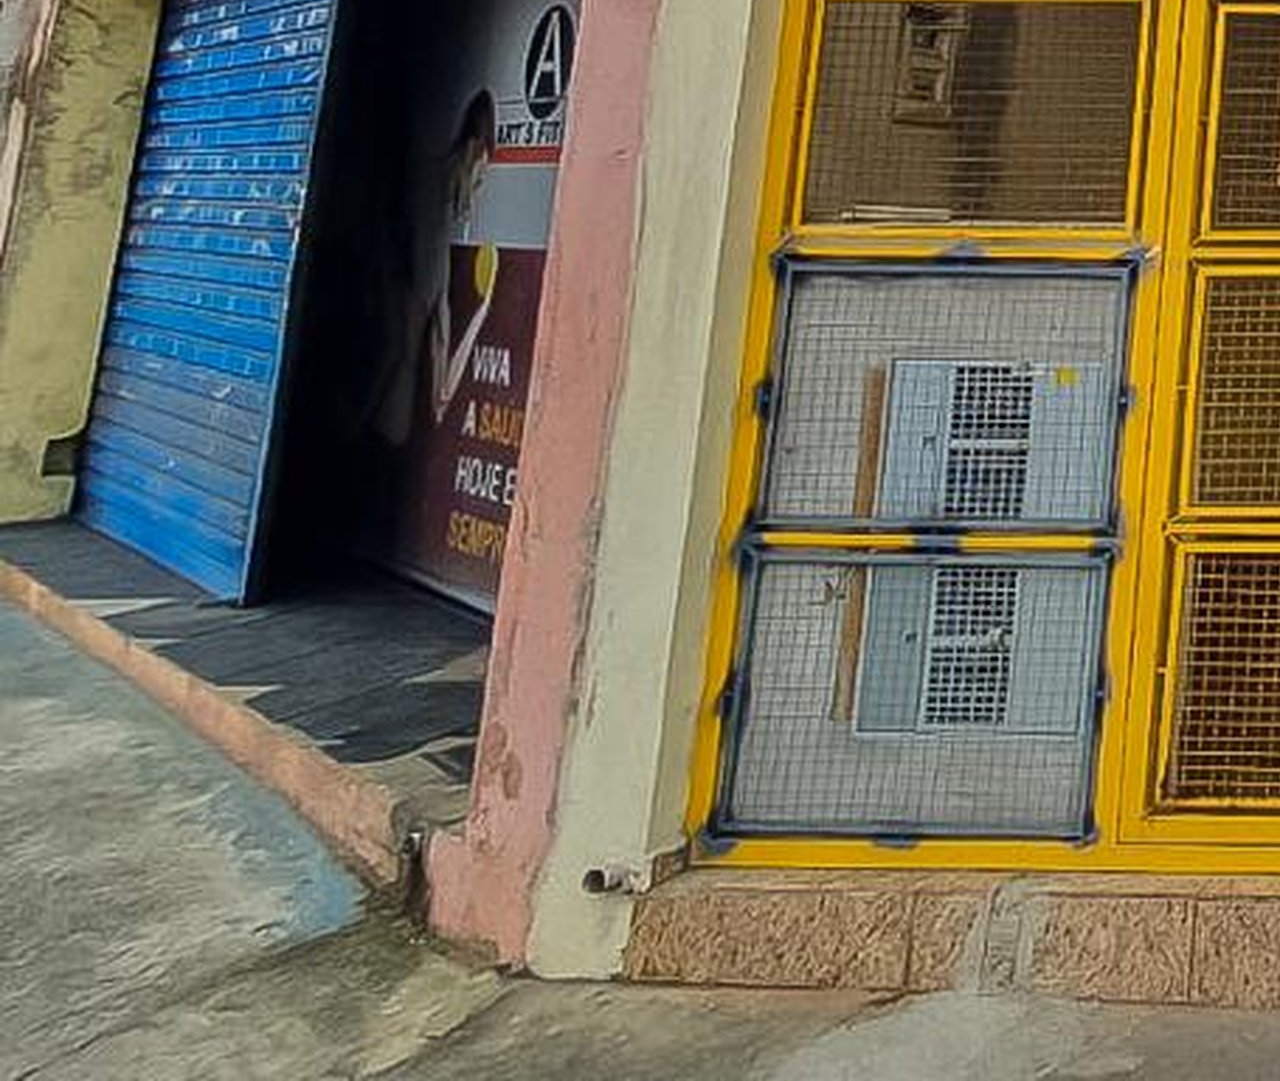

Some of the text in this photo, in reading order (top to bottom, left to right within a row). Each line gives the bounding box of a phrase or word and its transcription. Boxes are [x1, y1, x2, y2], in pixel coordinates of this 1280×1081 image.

[529, 10, 562, 99] A
[472, 345, 511, 388] VIVA
[460, 400, 477, 437] A
[455, 455, 502, 503] HOJE
